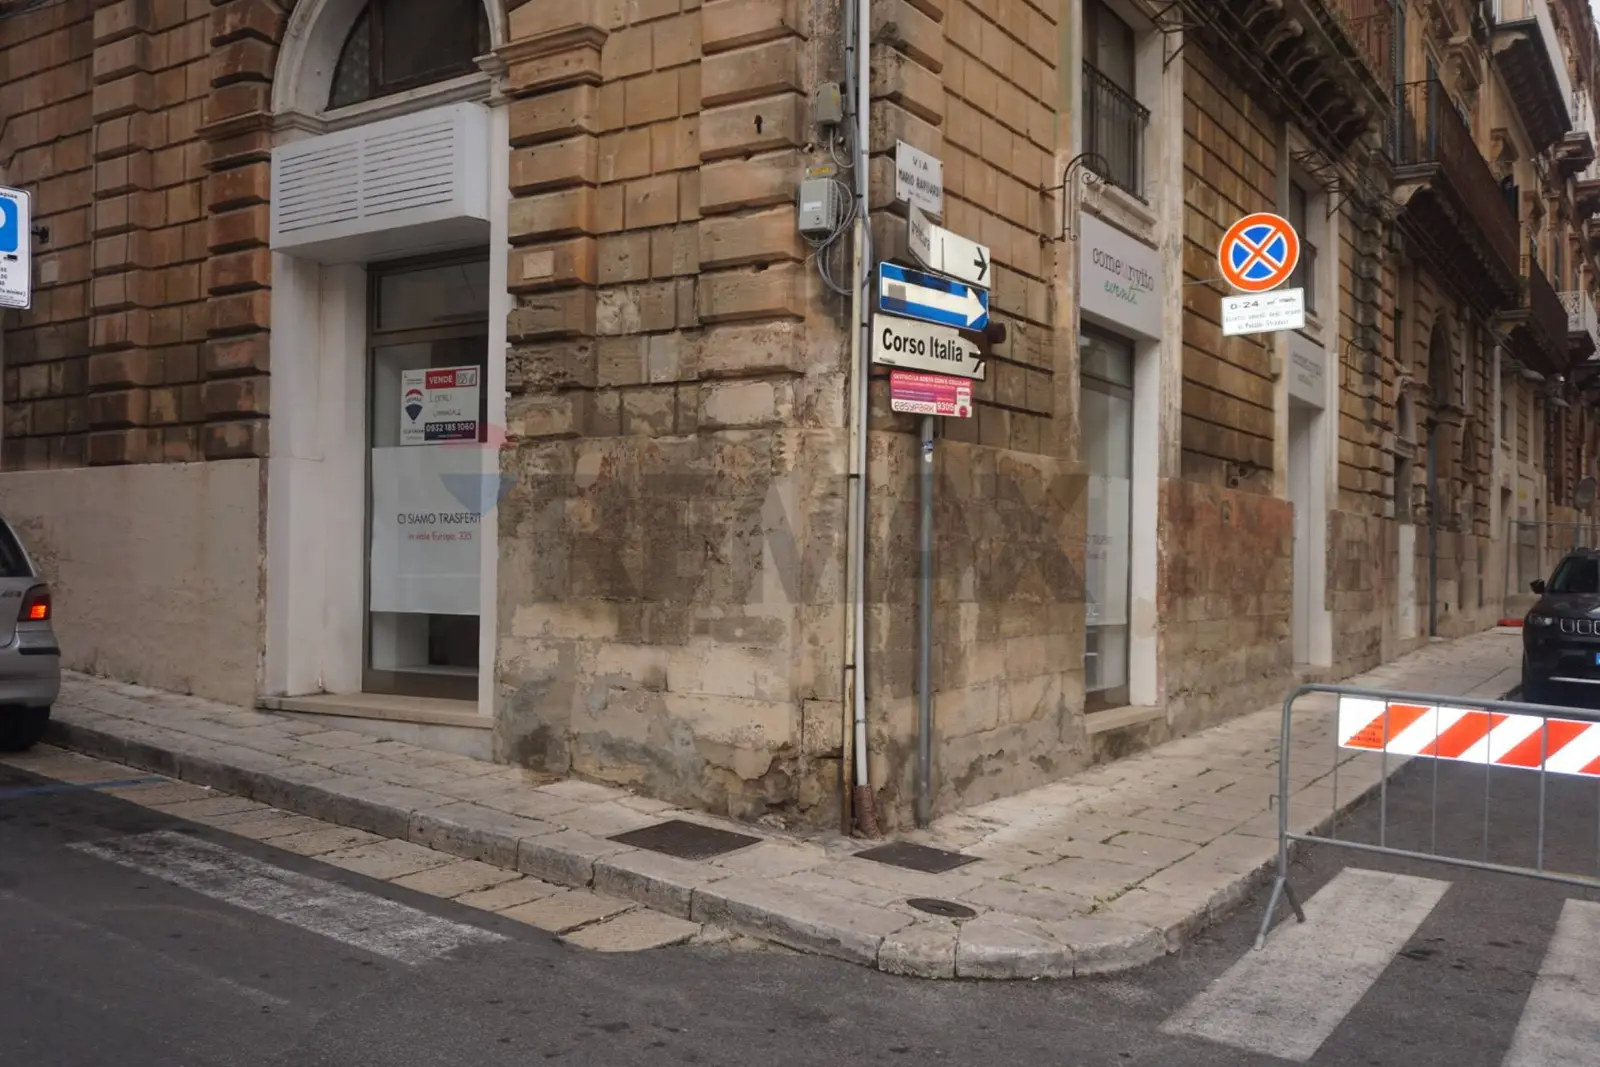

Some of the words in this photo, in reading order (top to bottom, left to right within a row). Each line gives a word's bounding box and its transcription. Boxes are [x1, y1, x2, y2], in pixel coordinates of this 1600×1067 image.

[912, 156, 928, 171] VIA
[882, 328, 925, 356] Corso
[930, 336, 962, 362] Italia
[397, 513, 406, 524] CI
[408, 513, 436, 524] SIAMO
